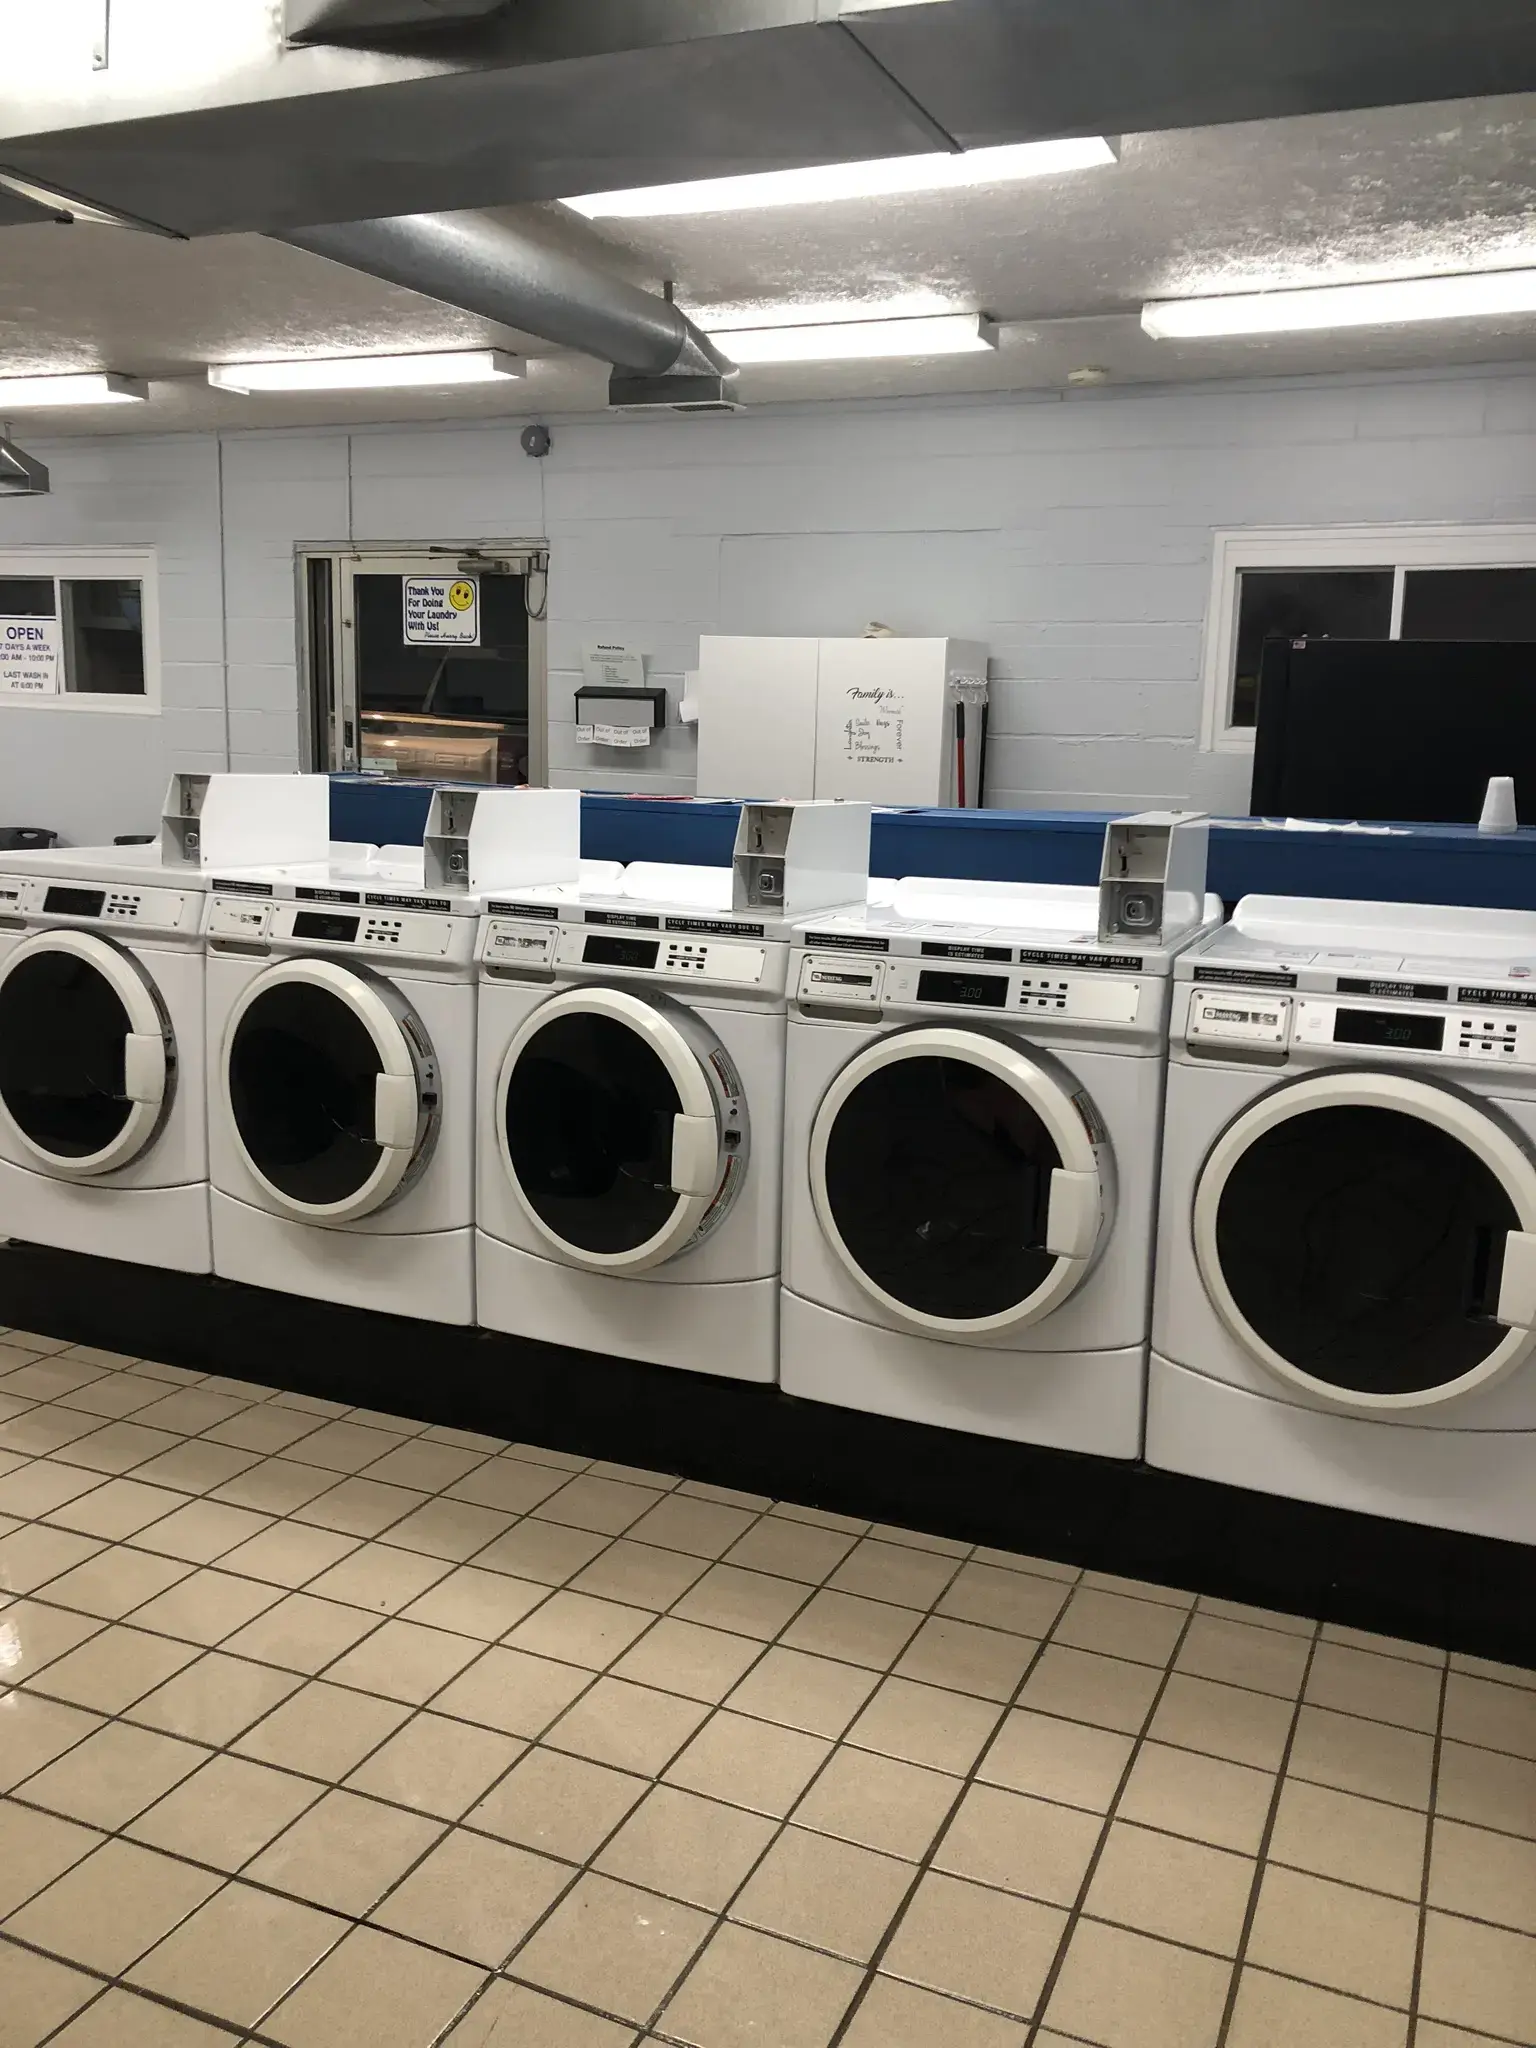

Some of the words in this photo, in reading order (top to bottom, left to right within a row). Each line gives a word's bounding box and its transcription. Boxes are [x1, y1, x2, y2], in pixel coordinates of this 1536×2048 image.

[408, 586, 430, 595] Thank
[431, 587, 444, 596] You
[408, 598, 420, 607] For
[422, 598, 443, 608] Doing
[408, 610, 425, 619] Your
[427, 610, 457, 620] Laundry
[408, 621, 425, 630] With
[427, 622, 440, 631] Us!
[6, 626, 44, 640] OPEN
[5, 643, 24, 651] DAYS
[23, 671, 41, 679] WASH
[846, 687, 884, 704] Family
[857, 755, 894, 763] STRENGTH
[1047, 952, 1069, 960] TIMES
[1370, 981, 1397, 989] DISPLAY
[1461, 988, 1487, 997] CYCLE
[1491, 990, 1517, 999] TIMES
